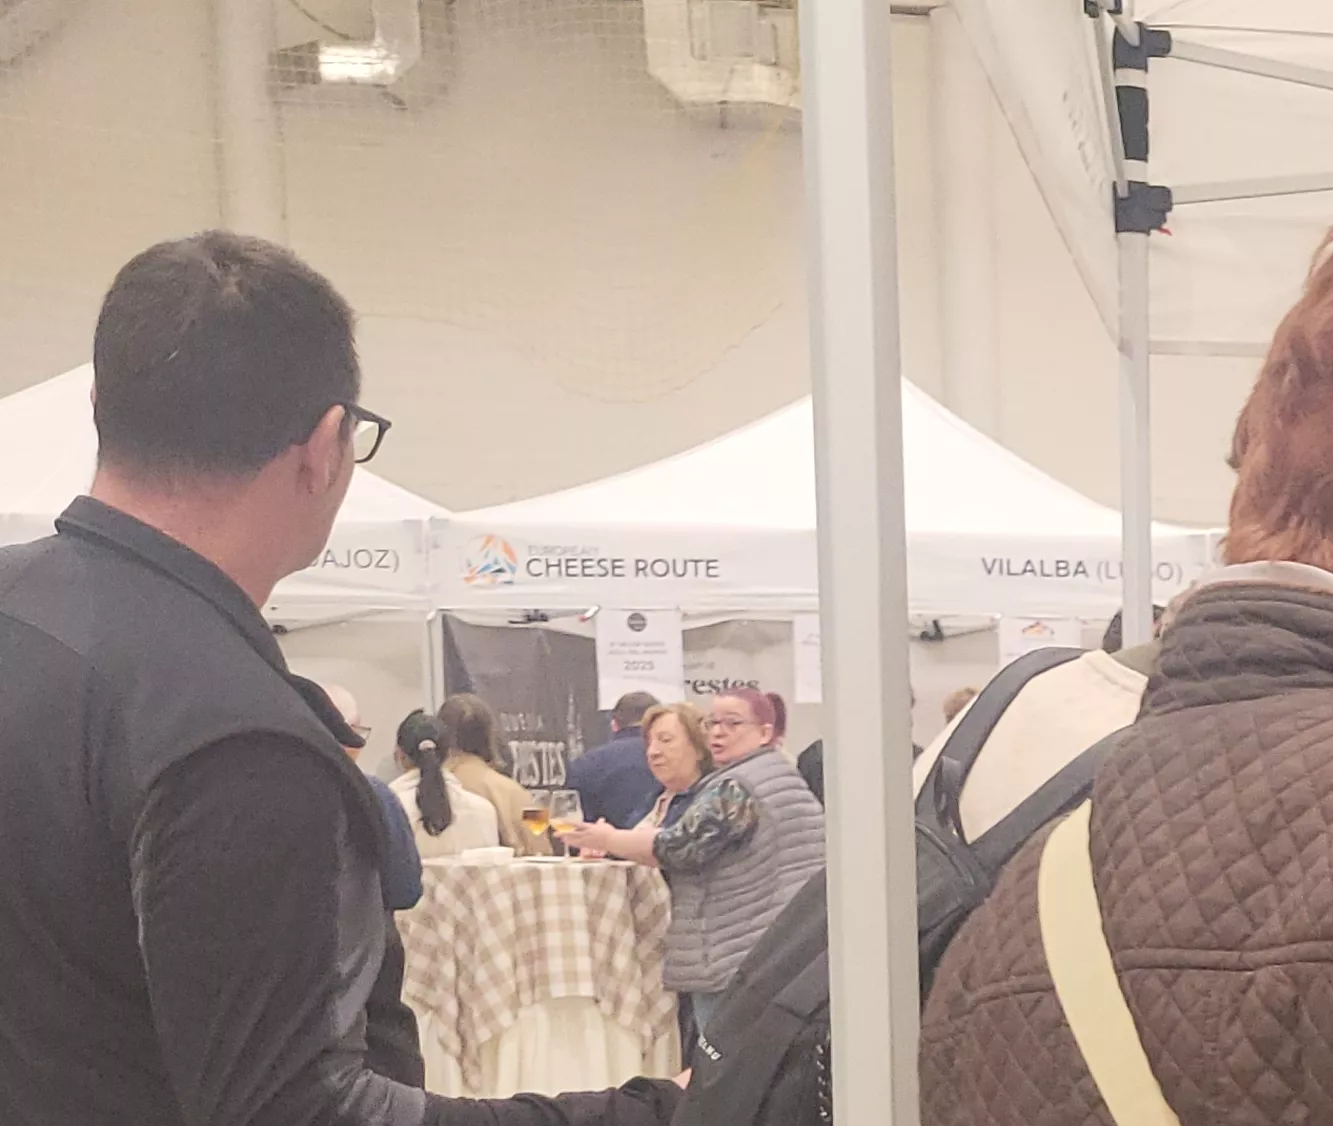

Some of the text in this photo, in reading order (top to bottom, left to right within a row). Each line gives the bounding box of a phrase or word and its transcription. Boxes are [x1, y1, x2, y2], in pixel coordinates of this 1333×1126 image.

[526, 557, 720, 578] CHEESE ROUTE
[982, 556, 1183, 584] VILALBA (LO)
